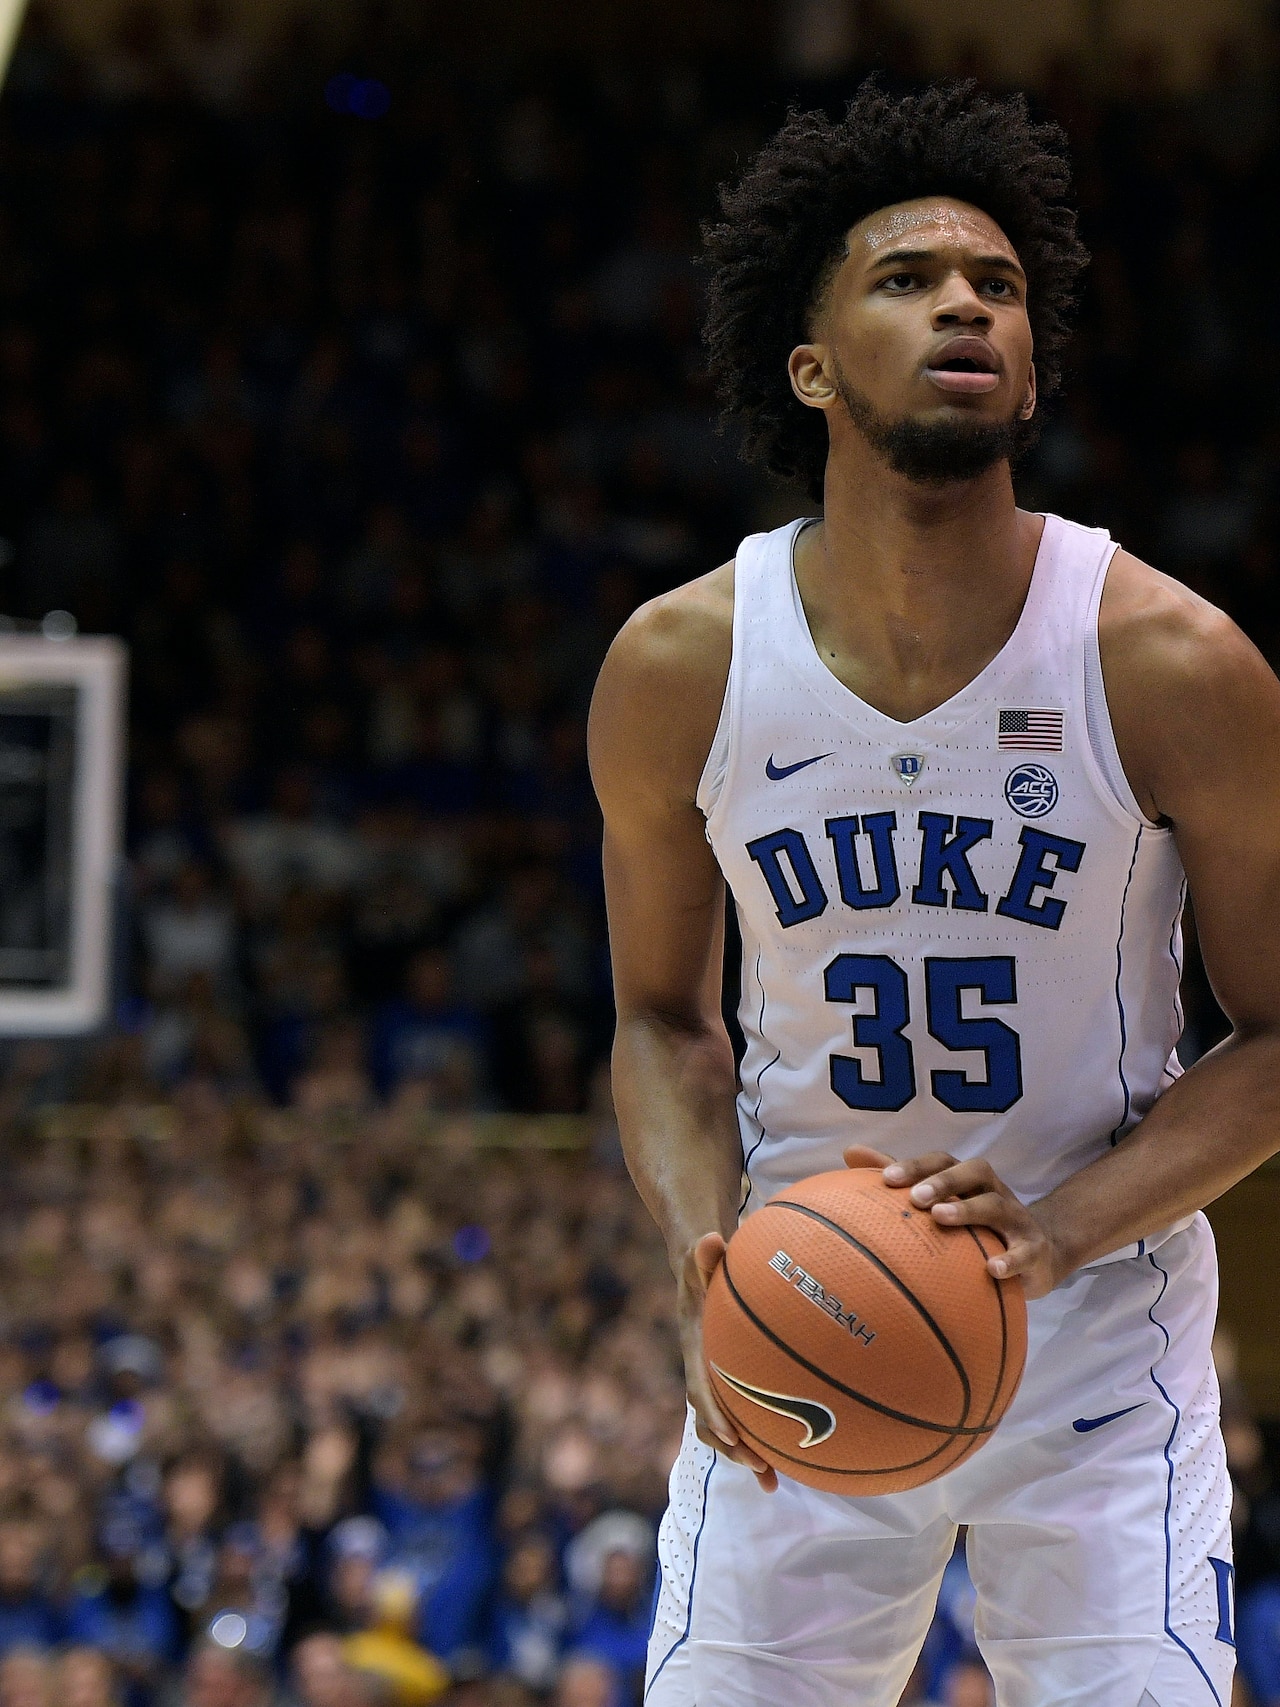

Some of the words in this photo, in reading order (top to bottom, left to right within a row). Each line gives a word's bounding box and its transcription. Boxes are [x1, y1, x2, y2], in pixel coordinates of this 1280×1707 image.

[1013, 781, 1055, 794] ACC
[745, 810, 1087, 931] DUKE
[823, 952, 1024, 1113] 35
[768, 1250, 876, 1347] HYPERELITE
